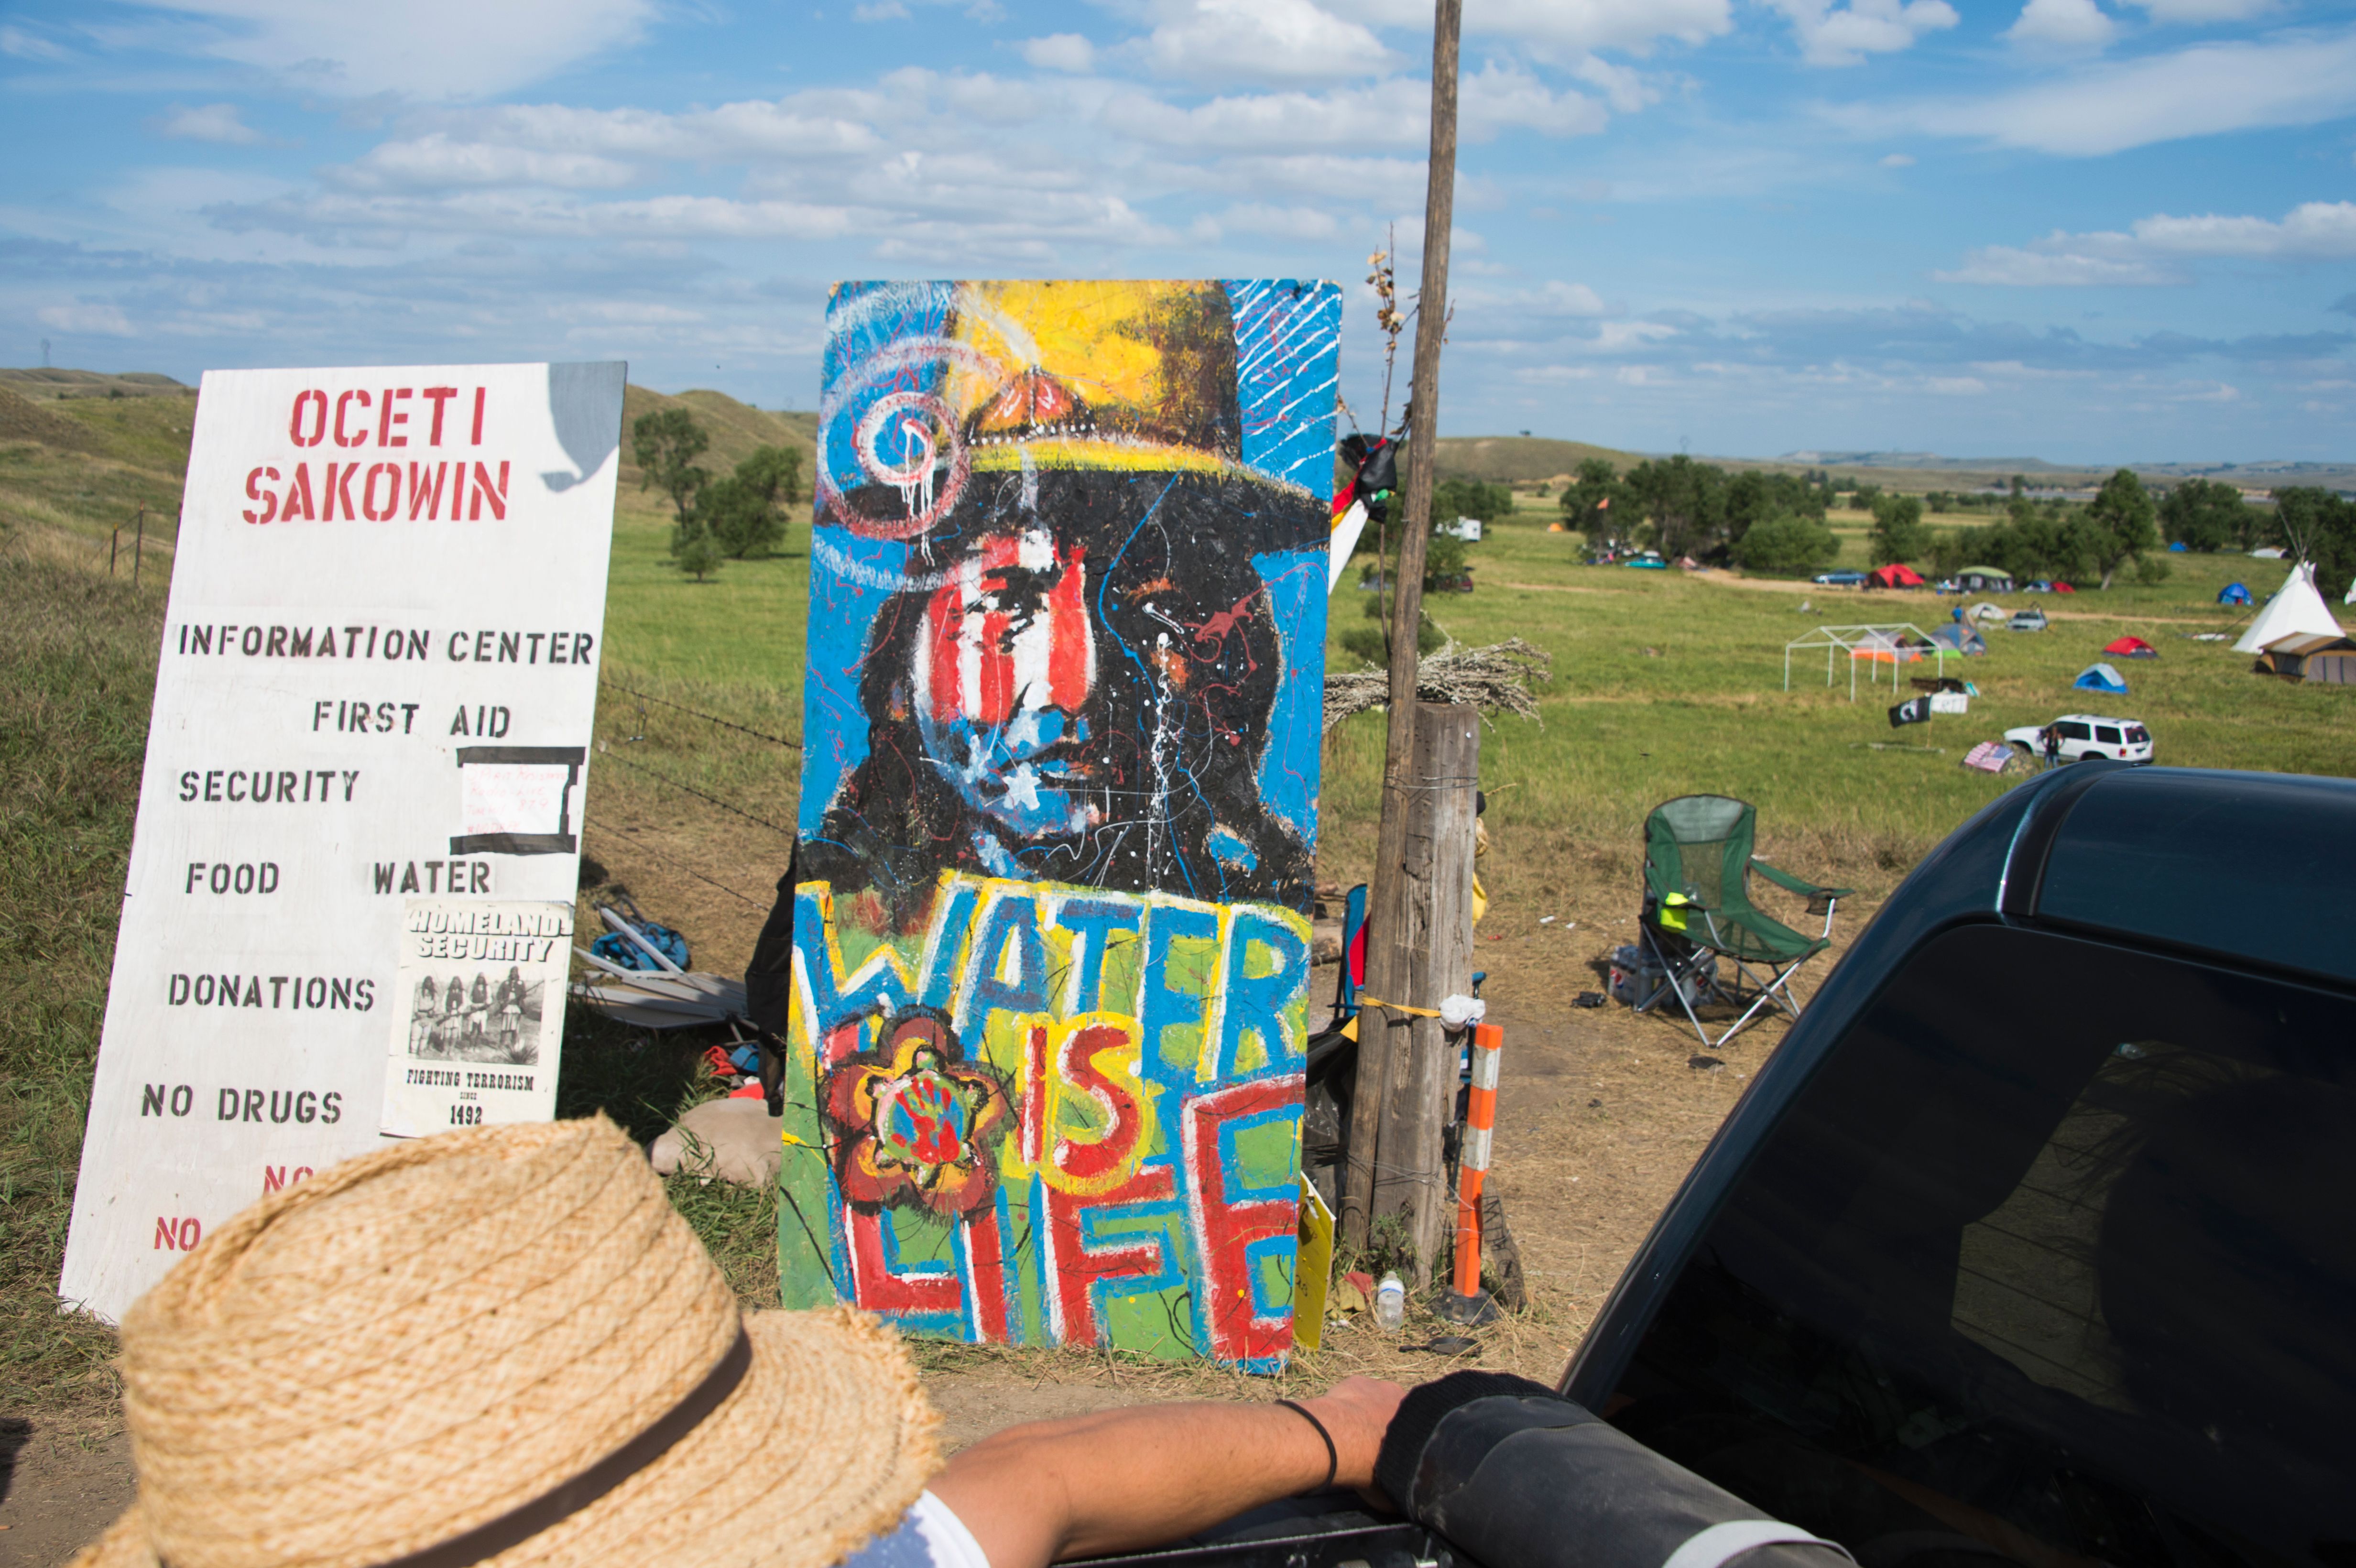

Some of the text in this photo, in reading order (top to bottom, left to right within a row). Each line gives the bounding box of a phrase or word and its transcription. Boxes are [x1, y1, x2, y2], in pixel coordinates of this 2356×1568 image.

[289, 386, 486, 448] OCETI
[242, 460, 511, 525] SAKOWIN
[179, 624, 593, 665] INFORMATION CENTER
[313, 700, 510, 739] FIRST AID
[179, 770, 360, 803] SECURITY
[185, 862, 280, 895] FOOD
[374, 860, 490, 895] WATER
[409, 909, 563, 937] HOMELAND
[415, 936, 554, 962] SECURITY
[168, 973, 375, 1012] DONATIONS
[790, 868, 1312, 1088] WATER
[406, 1068, 534, 1091] FIGHTING TERRORISM
[459, 1091, 478, 1100] SINCE
[141, 1083, 342, 1124] NO DRUGS
[450, 1104, 483, 1125] 1492
[1014, 1013, 1153, 1196] IS
[153, 1216, 202, 1252] NO
[838, 1073, 1306, 1368] LIFE
